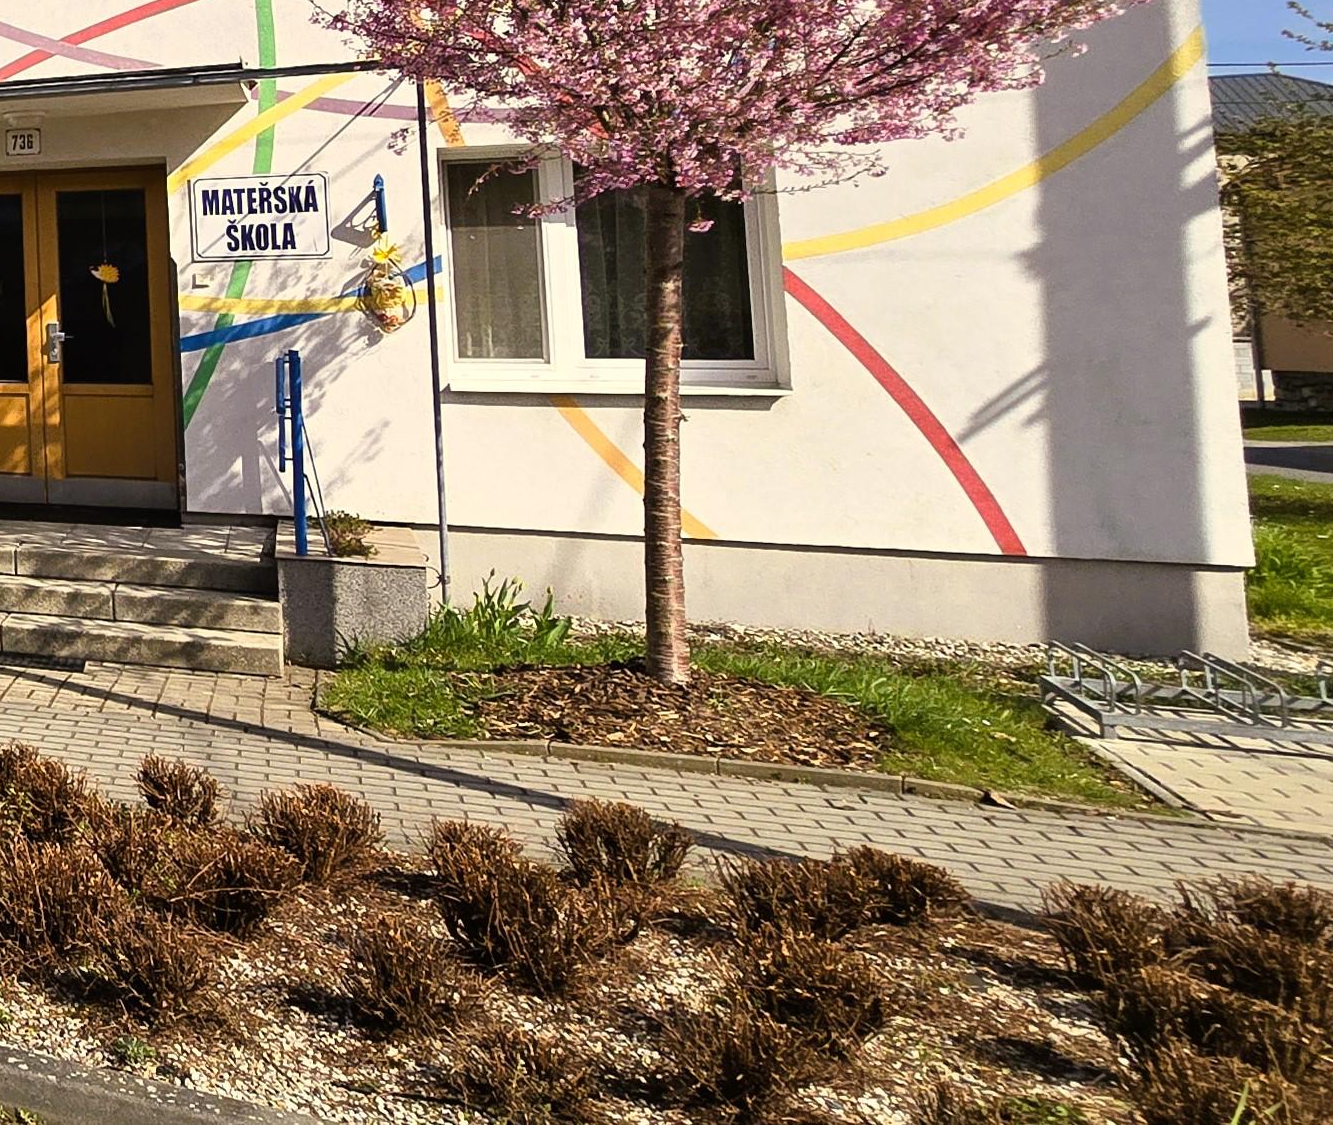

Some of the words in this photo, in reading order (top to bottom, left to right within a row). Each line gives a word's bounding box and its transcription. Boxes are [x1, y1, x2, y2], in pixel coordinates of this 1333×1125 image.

[11, 133, 34, 151] 736
[201, 179, 319, 216] MATEŘSKÁ
[225, 218, 297, 252] ŠKOLA
